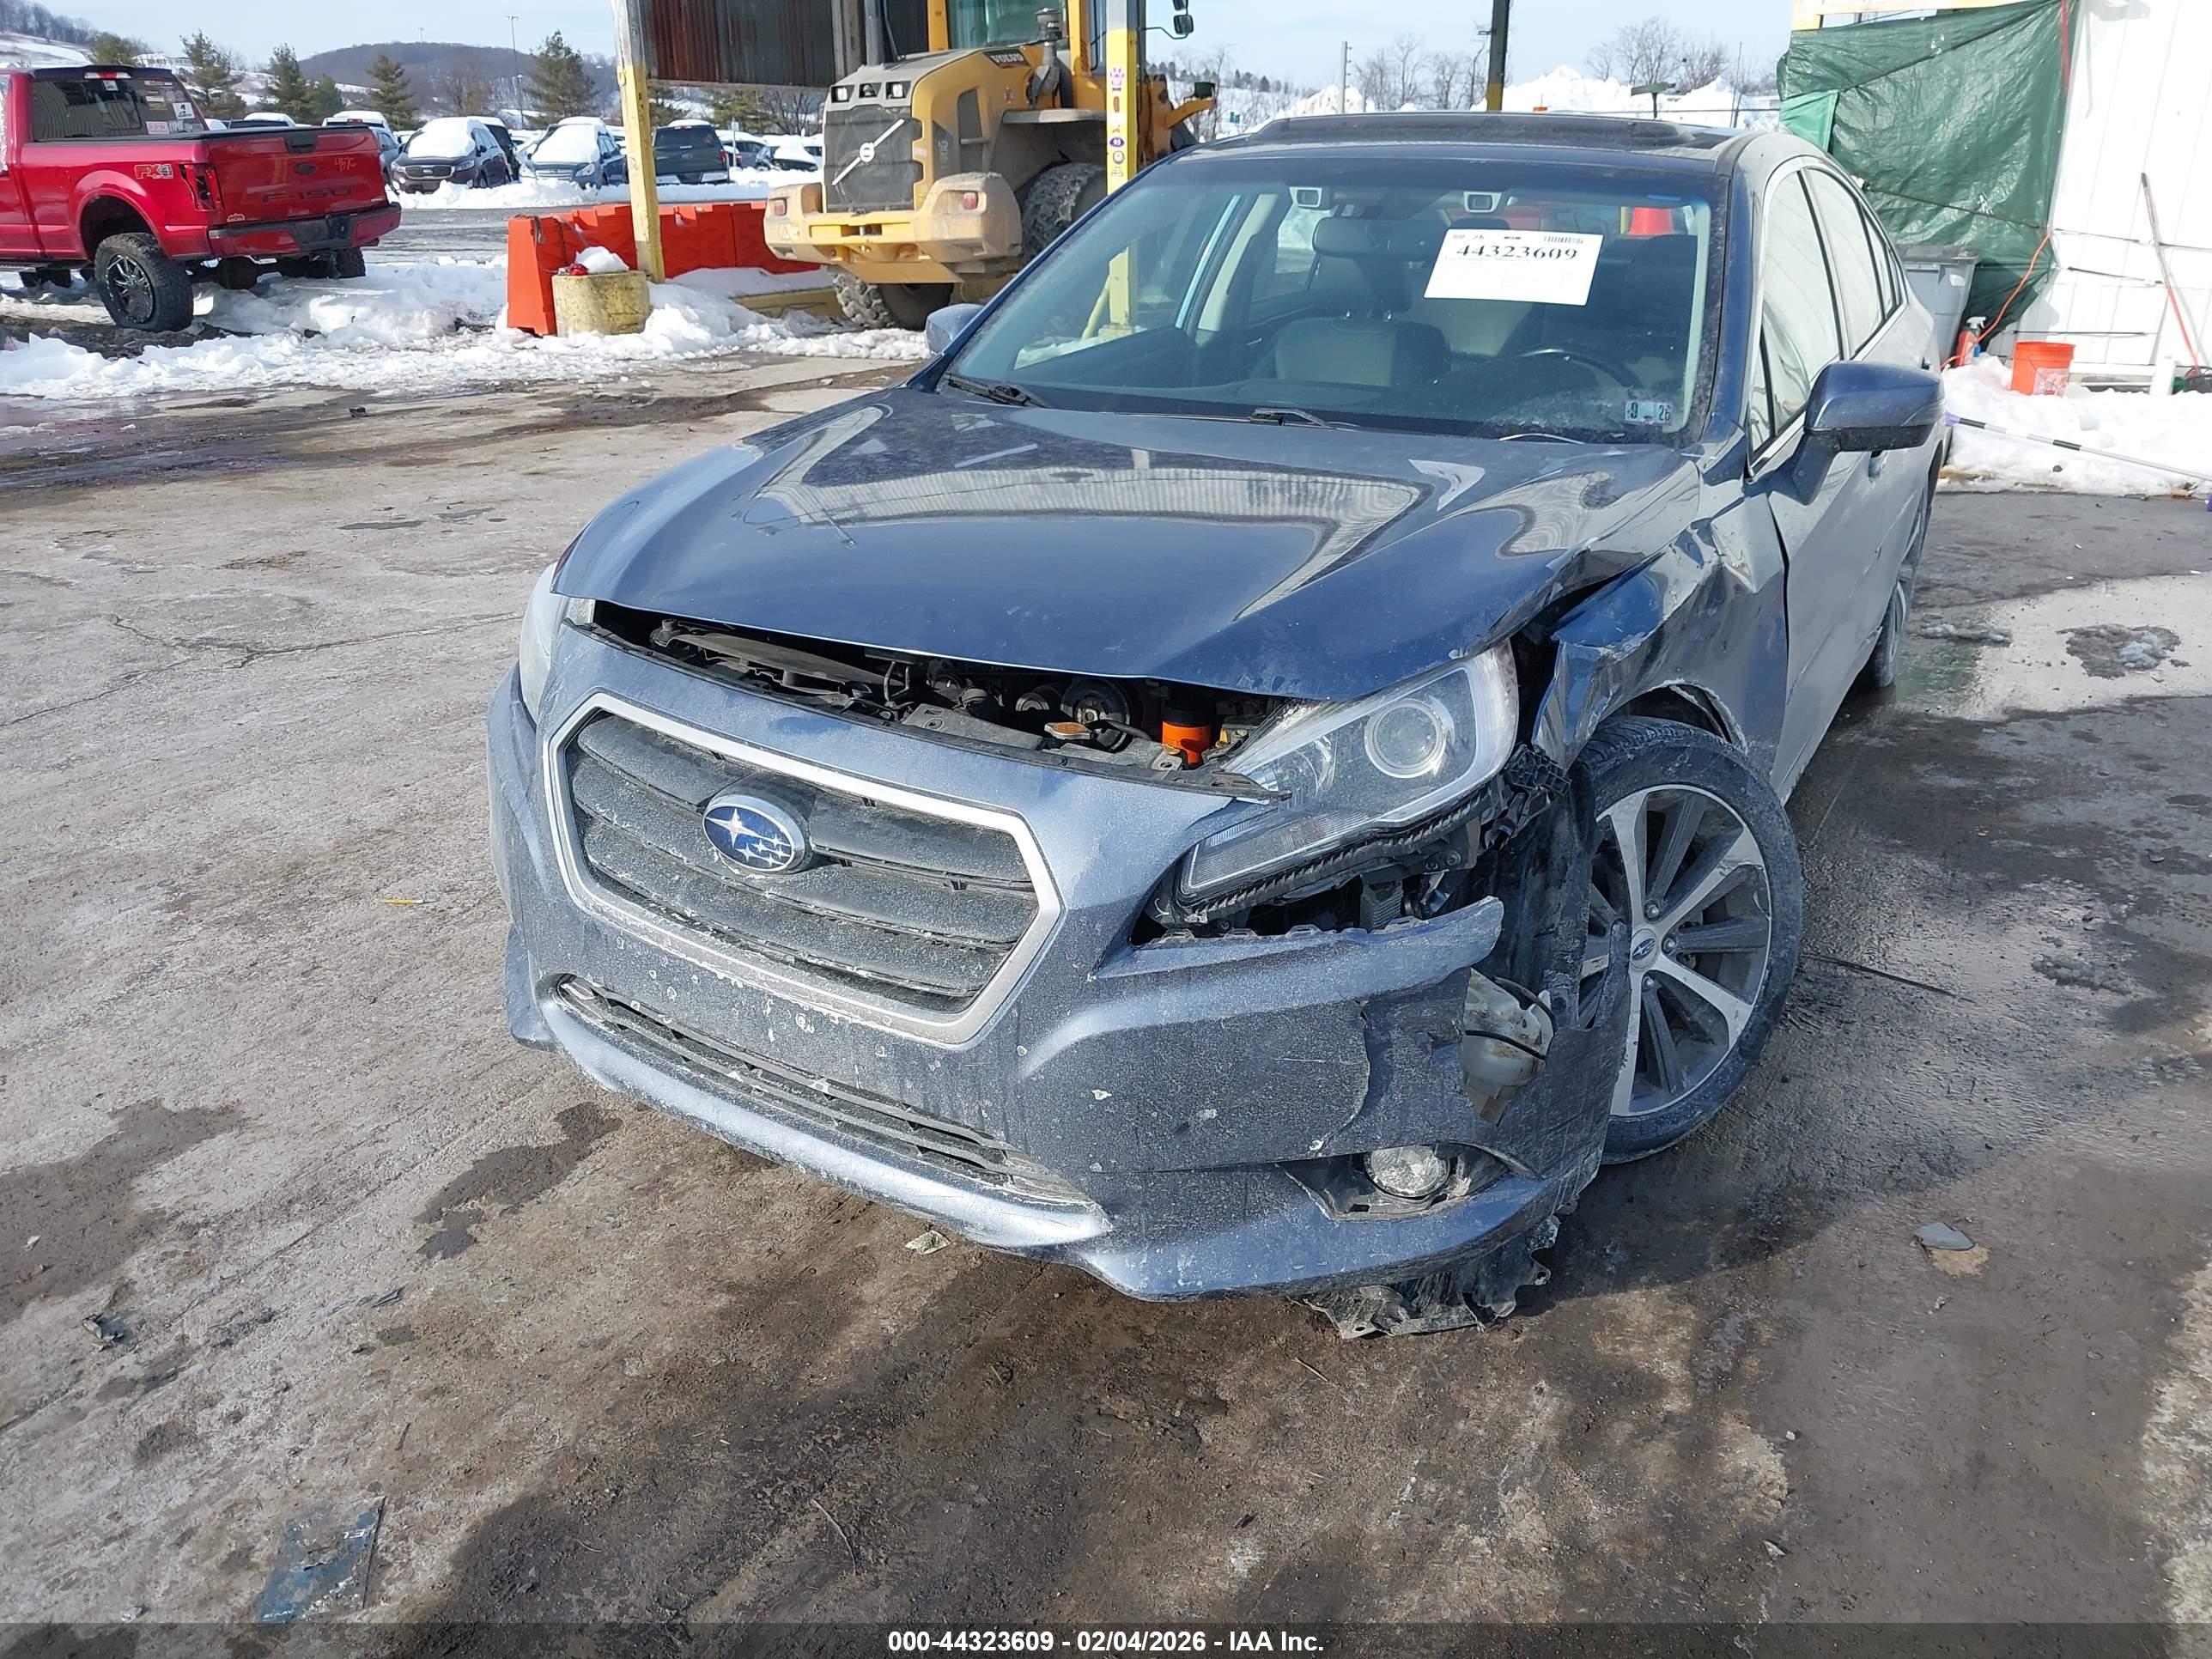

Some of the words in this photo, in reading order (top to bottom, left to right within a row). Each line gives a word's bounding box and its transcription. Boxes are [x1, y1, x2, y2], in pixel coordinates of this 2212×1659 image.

[989, 52, 1024, 63] VOLVO
[134, 164, 173, 179] FX4
[1456, 244, 1577, 259] 44323609
[1658, 404, 1671, 422] 26
